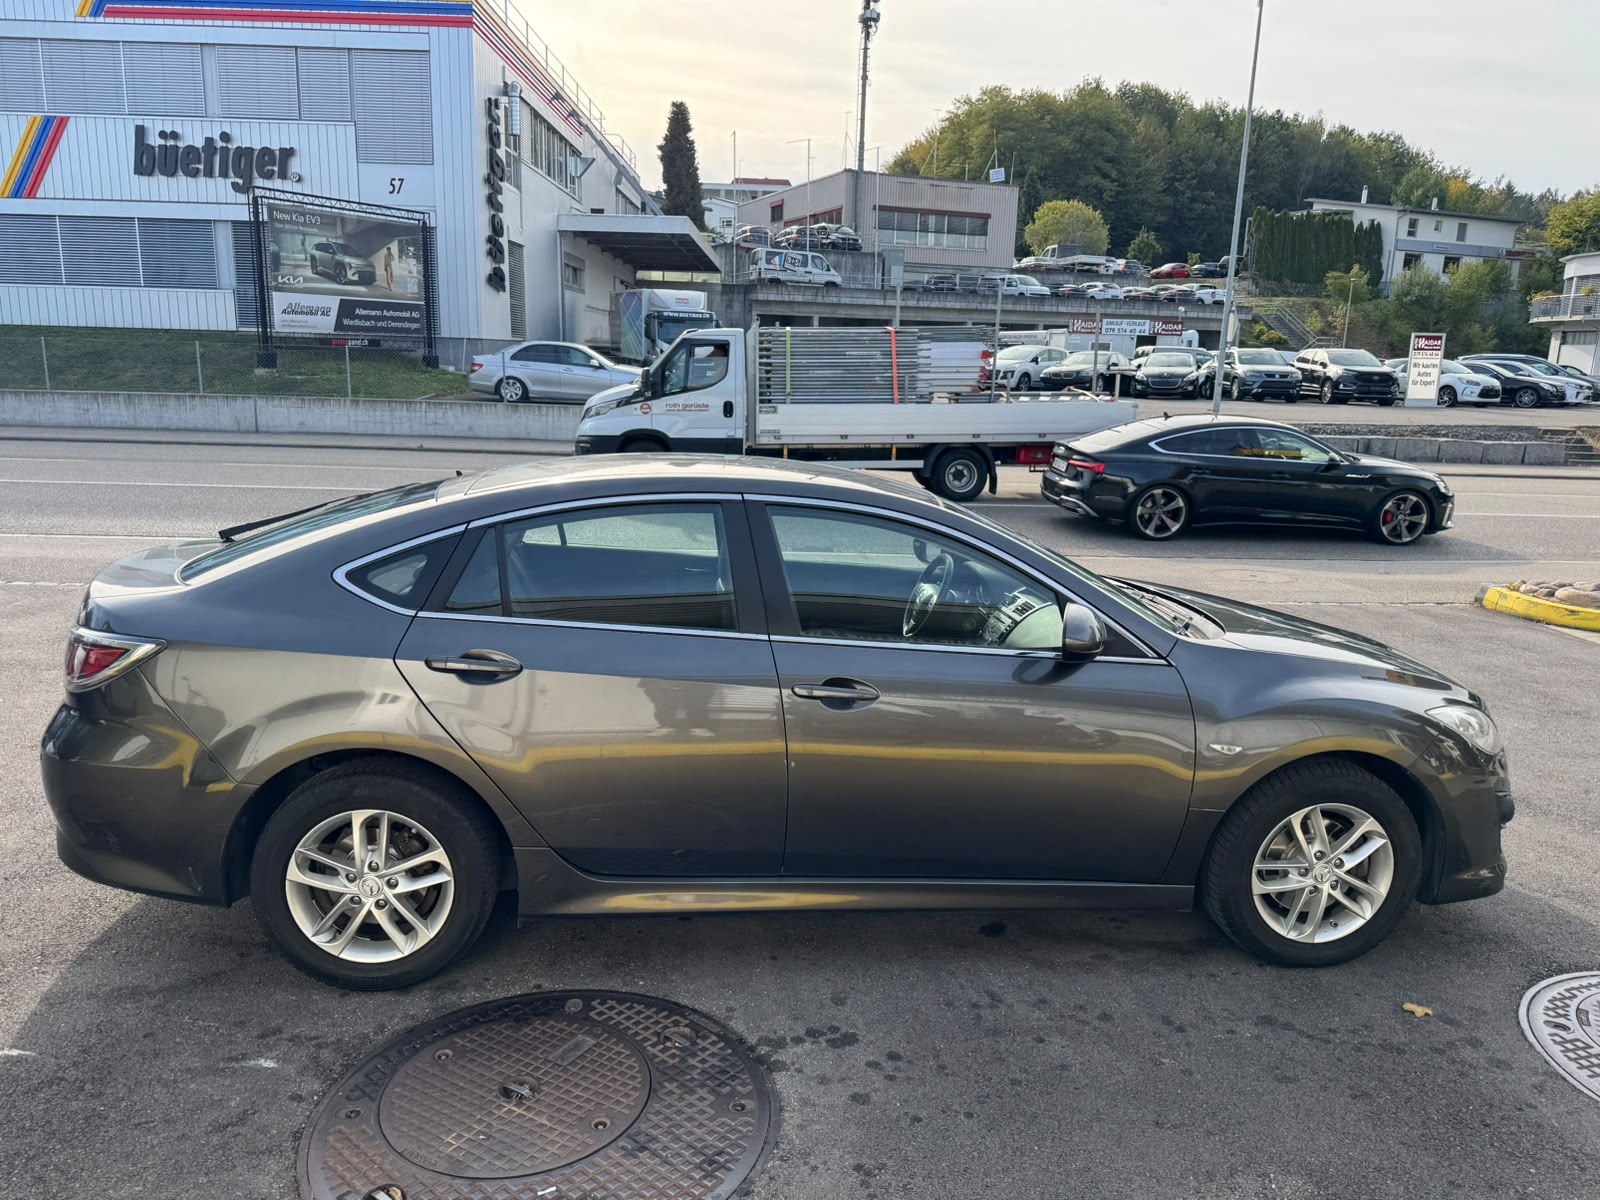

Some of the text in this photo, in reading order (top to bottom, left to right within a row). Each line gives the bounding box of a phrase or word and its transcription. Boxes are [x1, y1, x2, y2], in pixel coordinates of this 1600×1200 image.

[388, 177, 405, 195] 57
[273, 210, 321, 225] New Kia EV3
[281, 308, 319, 317] Automobil
[285, 302, 332, 313] Allemann
[355, 307, 420, 319] Allemann Automobil AG
[342, 318, 376, 327] Wiedlisbach
[387, 321, 421, 330] Derendingen
[1413, 361, 1421, 369] Wir
